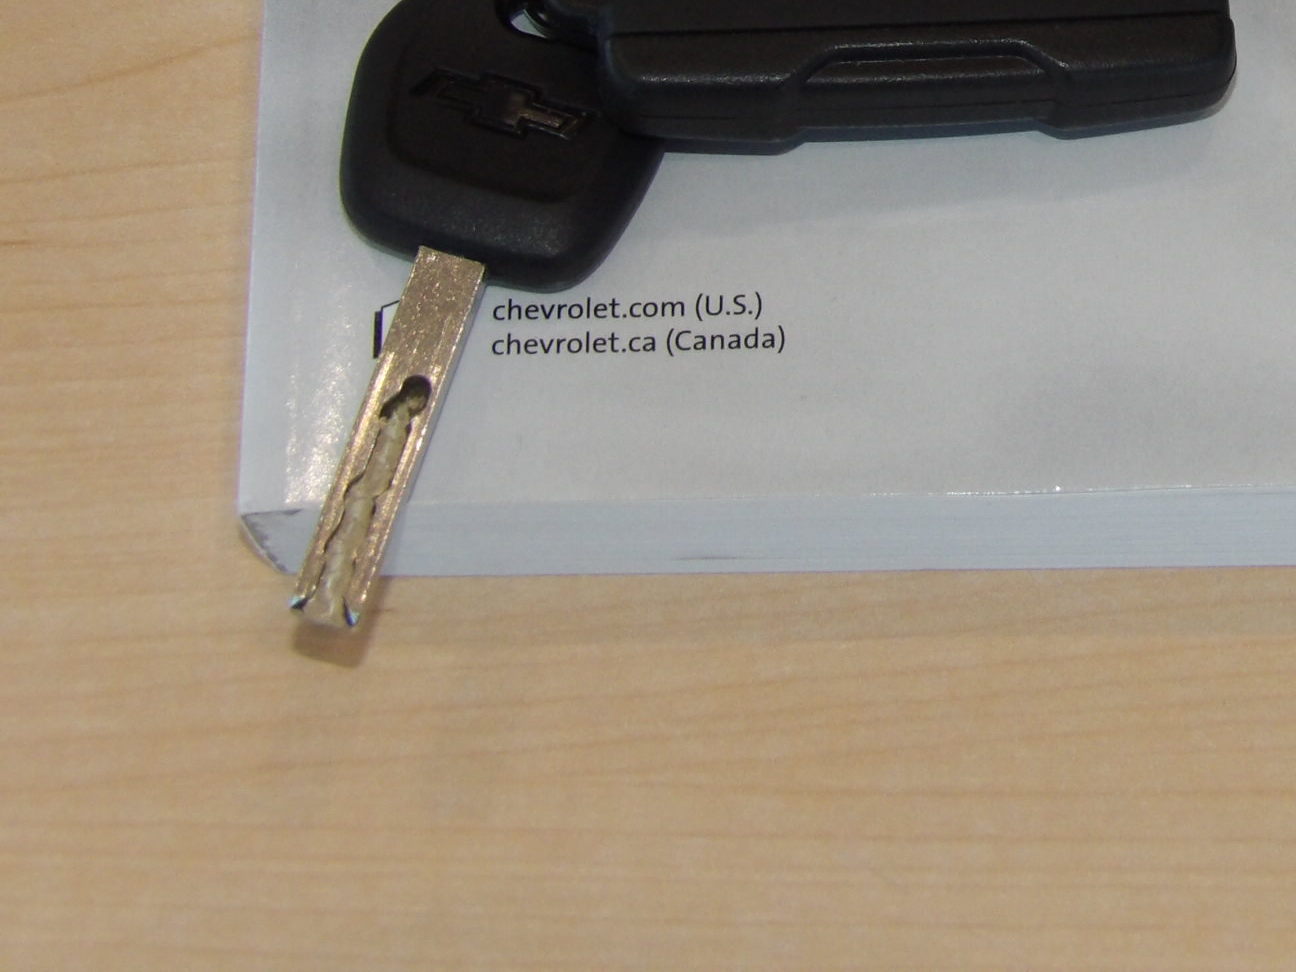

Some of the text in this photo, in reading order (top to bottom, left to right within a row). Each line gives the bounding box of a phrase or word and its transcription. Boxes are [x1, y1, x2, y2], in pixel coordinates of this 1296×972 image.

[491, 291, 764, 322] chevrolet.com (U.S.)
[490, 325, 787, 358] chevrolet.ca (Canada)
